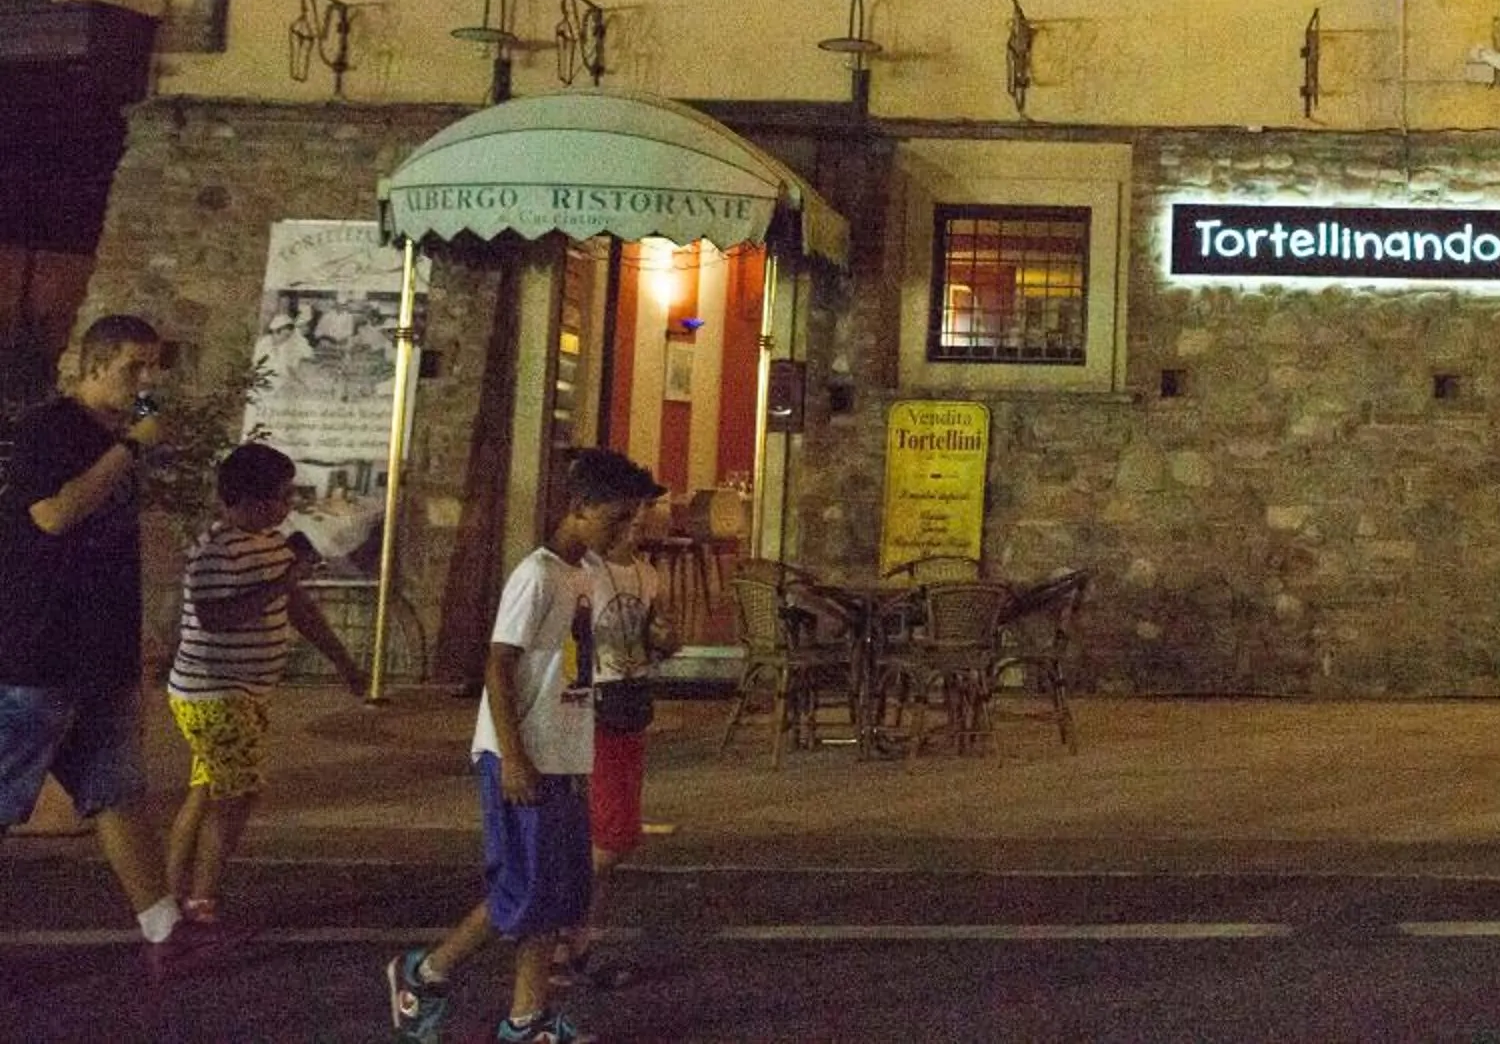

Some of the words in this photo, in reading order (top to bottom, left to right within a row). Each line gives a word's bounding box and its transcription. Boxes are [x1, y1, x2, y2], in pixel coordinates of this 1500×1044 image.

[403, 186, 519, 213] ALBERGO
[552, 187, 751, 221] RISTORANTE
[908, 408, 974, 426] Vendita
[896, 428, 982, 451] Tortellini
